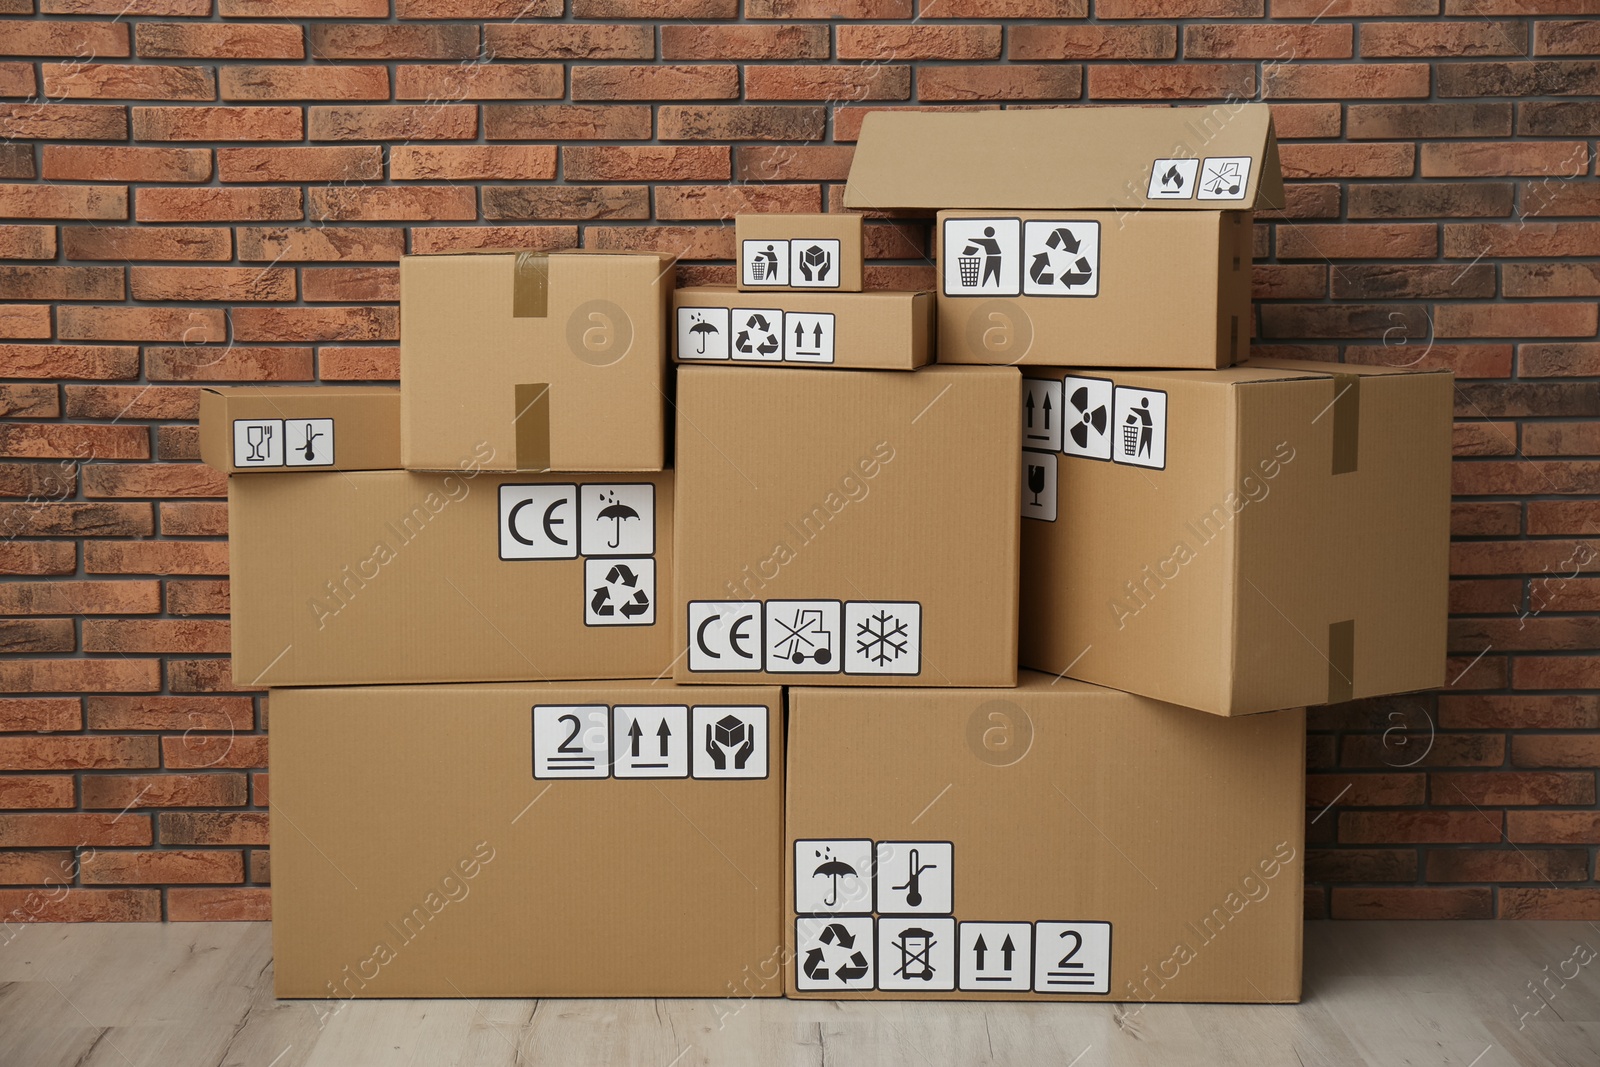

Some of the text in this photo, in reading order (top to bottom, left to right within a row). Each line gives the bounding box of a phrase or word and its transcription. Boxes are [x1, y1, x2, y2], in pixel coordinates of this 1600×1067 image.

[508, 498, 568, 546] CE
[696, 614, 753, 659] CE
[557, 714, 584, 753] 2
[1058, 930, 1084, 968] 2
